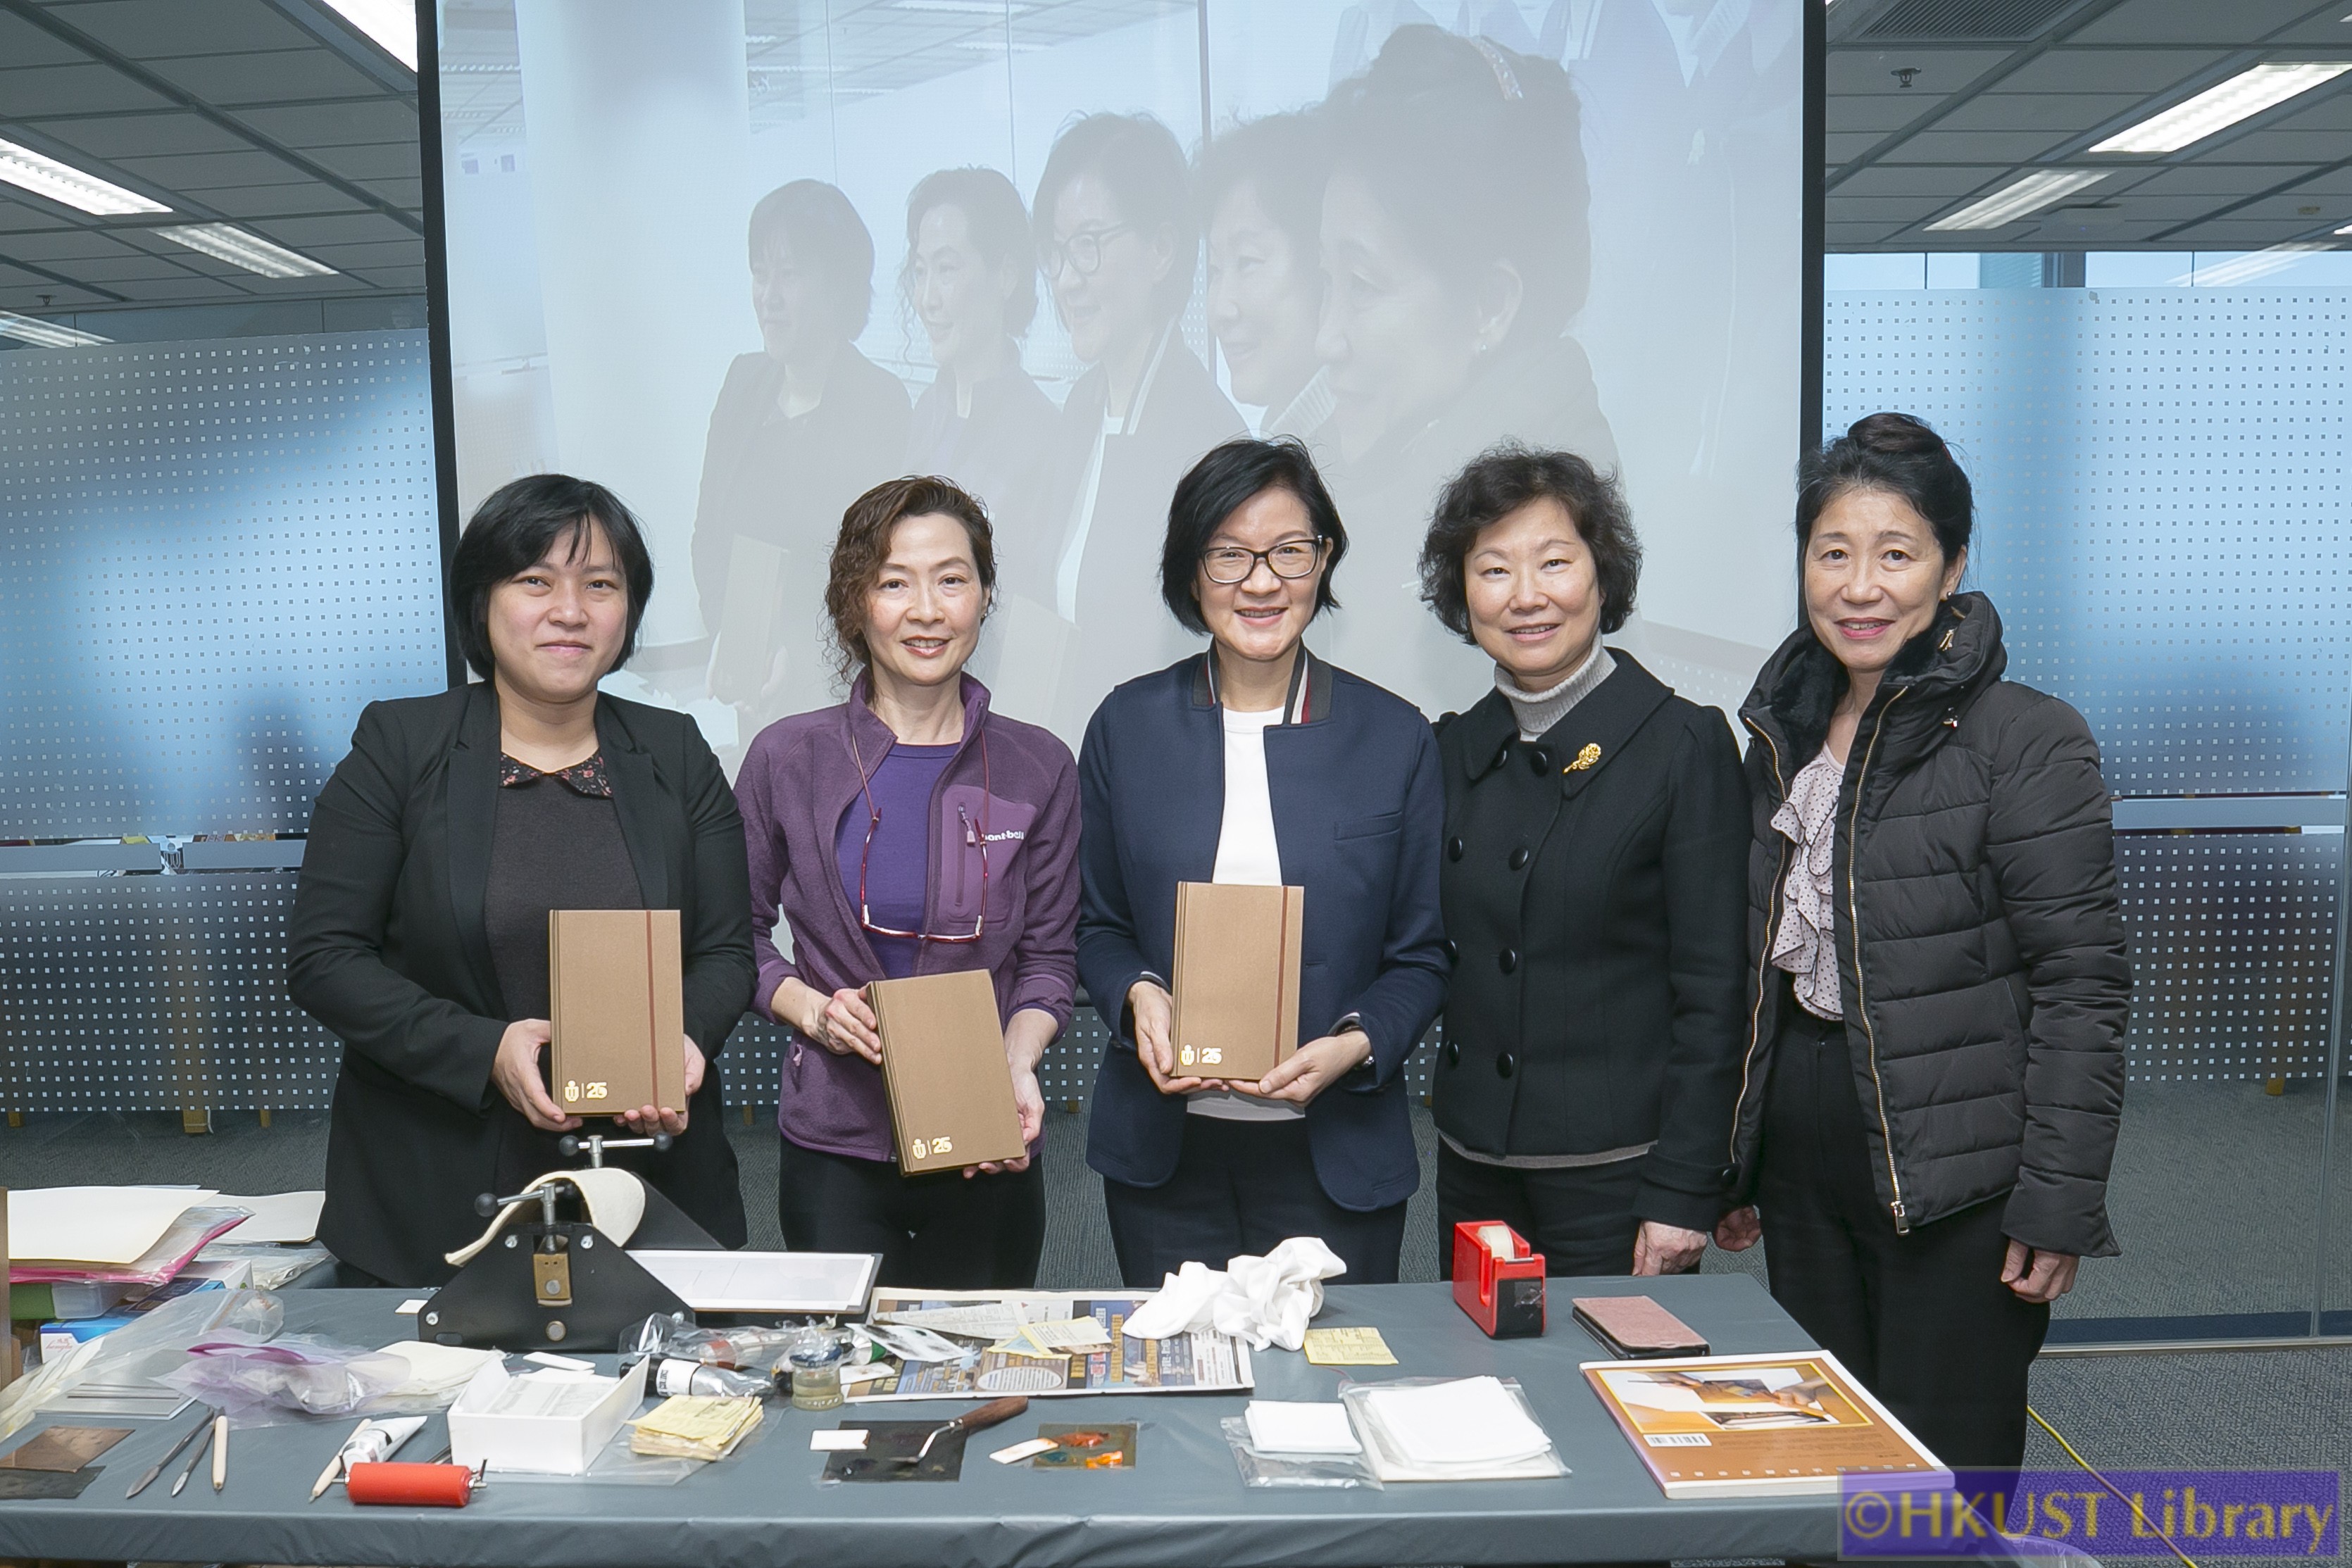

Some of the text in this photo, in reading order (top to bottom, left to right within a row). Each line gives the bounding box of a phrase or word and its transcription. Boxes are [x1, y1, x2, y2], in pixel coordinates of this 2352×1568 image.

[1201, 1047, 1222, 1064] 25
[587, 1082, 607, 1098] 25
[932, 1136, 952, 1153] 25
